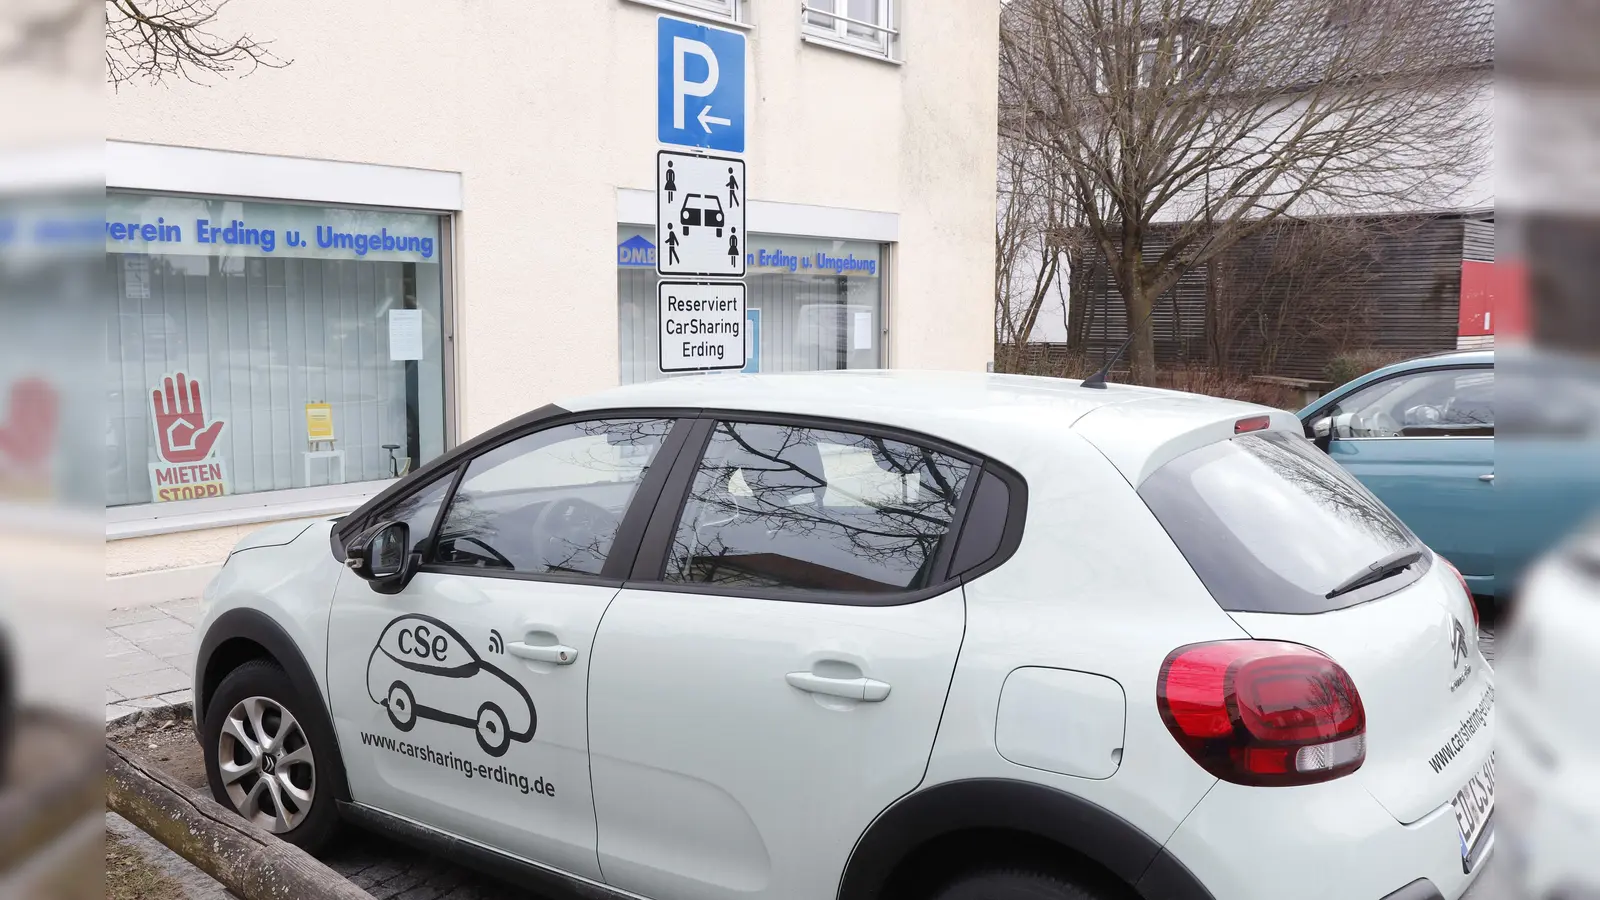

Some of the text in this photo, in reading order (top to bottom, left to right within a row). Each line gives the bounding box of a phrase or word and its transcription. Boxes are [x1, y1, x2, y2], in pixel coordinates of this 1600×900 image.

[673, 36, 719, 130] P
[196, 219, 276, 252] Erding
[285, 229, 307, 248] u.
[316, 225, 434, 259] Umgebung
[758, 249, 798, 272] Erding
[802, 257, 813, 269] u.
[816, 253, 876, 275] Umgebung
[668, 295, 737, 312] Reserviert
[666, 318, 739, 338] CarSharing
[682, 341, 724, 360] Erding
[155, 463, 222, 486] MIETEN
[360, 731, 555, 798] www.carsharing-erding.de
